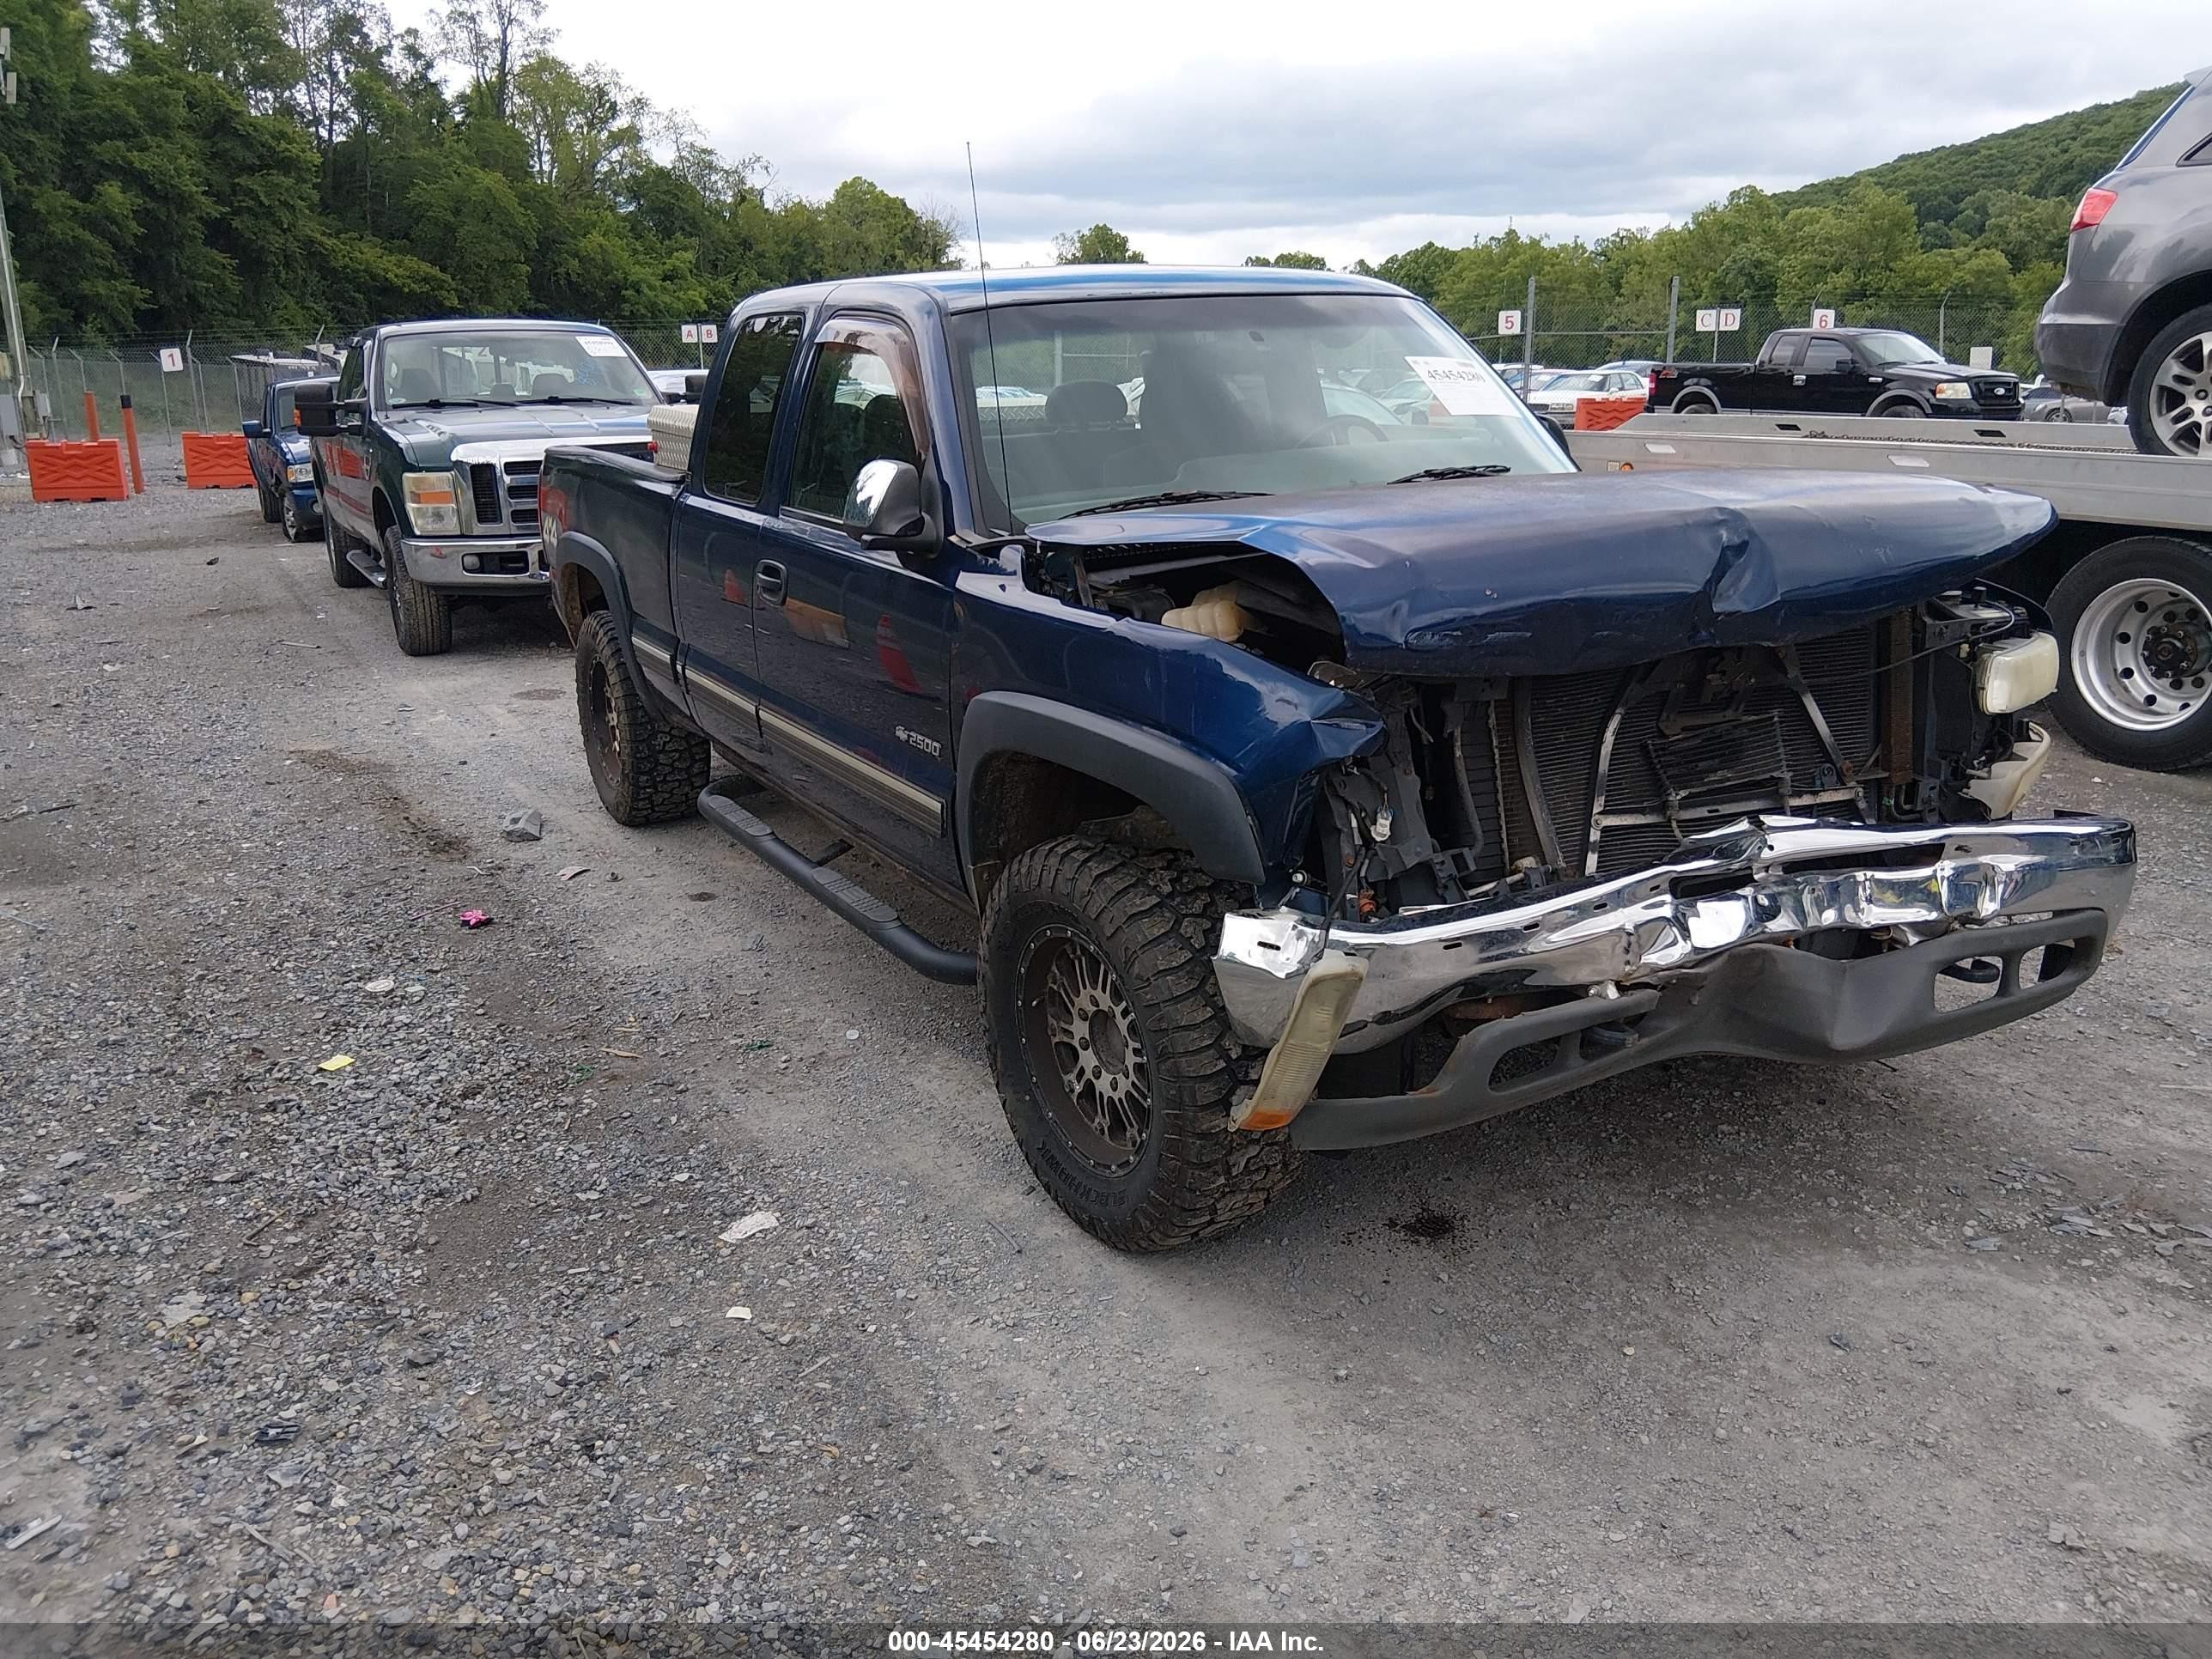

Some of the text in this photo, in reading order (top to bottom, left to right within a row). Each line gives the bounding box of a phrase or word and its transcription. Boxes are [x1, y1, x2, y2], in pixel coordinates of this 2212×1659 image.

[1504, 315, 1515, 330] 5
[1700, 313, 1711, 327] C
[1724, 313, 1735, 327] D
[1819, 314, 1828, 329] 6
[686, 329, 694, 339] A
[706, 329, 713, 338] B
[167, 352, 176, 367] 1
[909, 732, 942, 757] 2500
